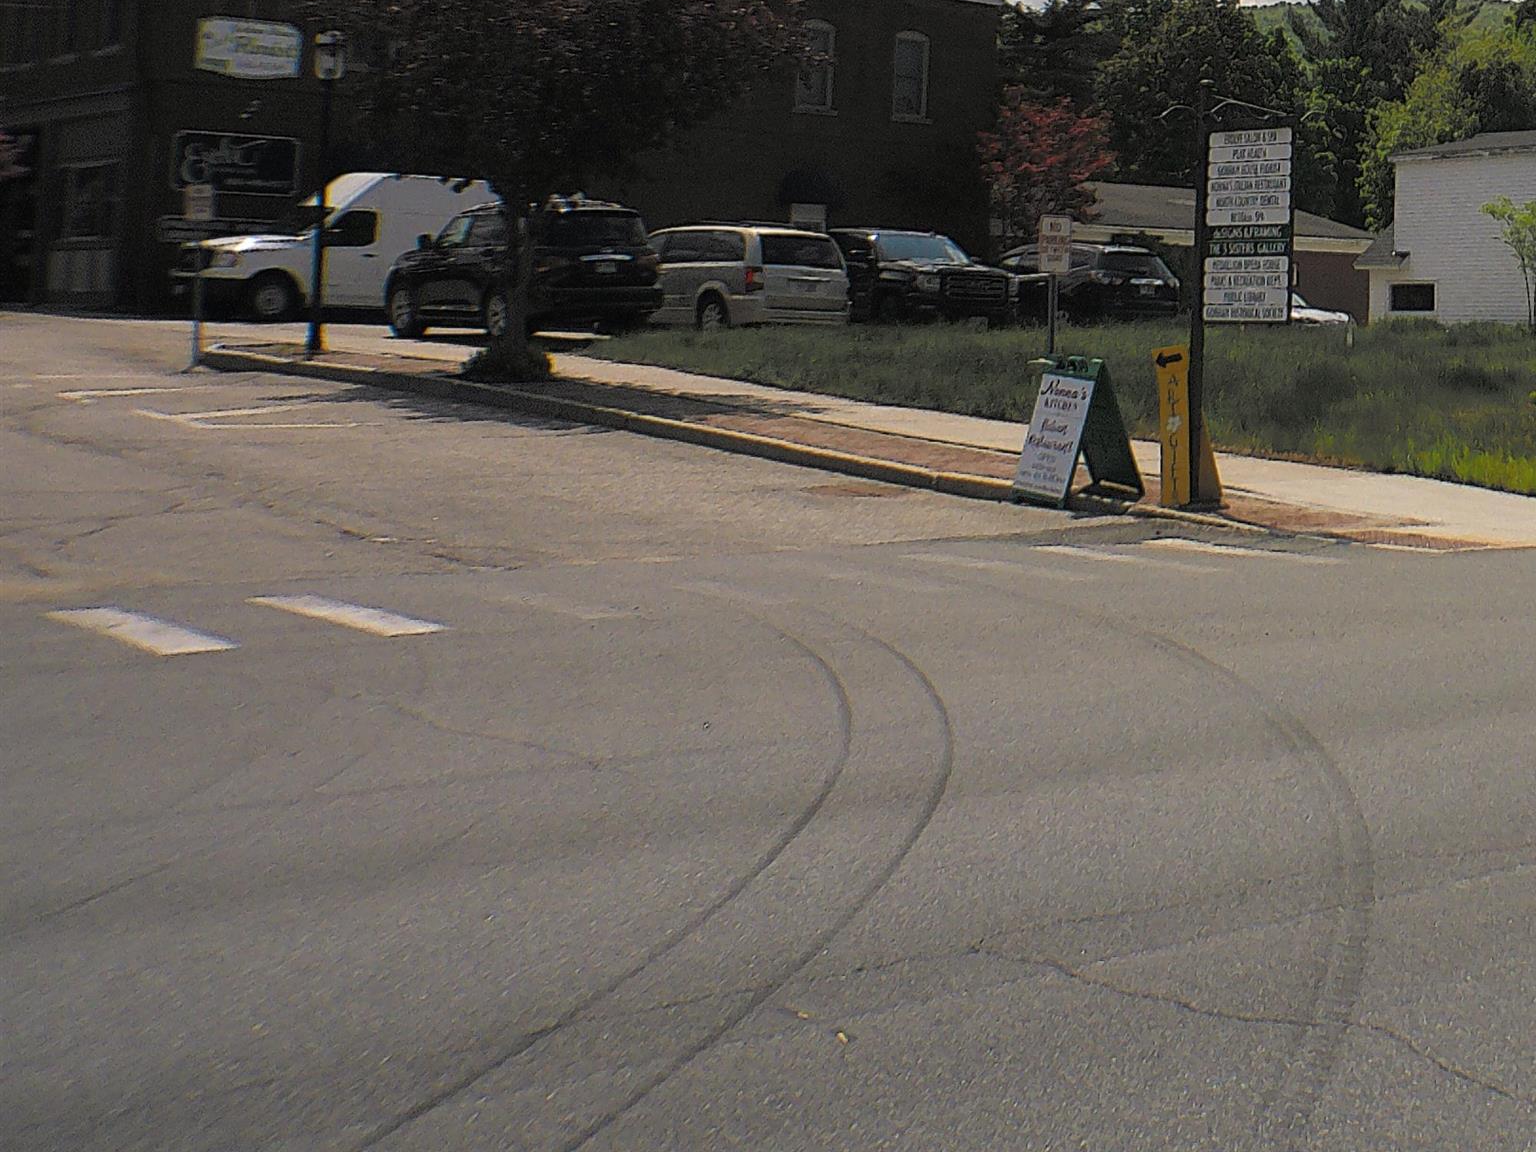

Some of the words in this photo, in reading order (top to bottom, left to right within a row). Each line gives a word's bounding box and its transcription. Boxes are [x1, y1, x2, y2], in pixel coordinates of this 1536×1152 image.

[1254, 178, 1287, 190] RESTAURANT
[1250, 226, 1282, 237] FRAMING
[1209, 244, 1220, 255] THE
[1257, 242, 1286, 254] GALLERY
[1040, 380, 1088, 400] Nonna's
